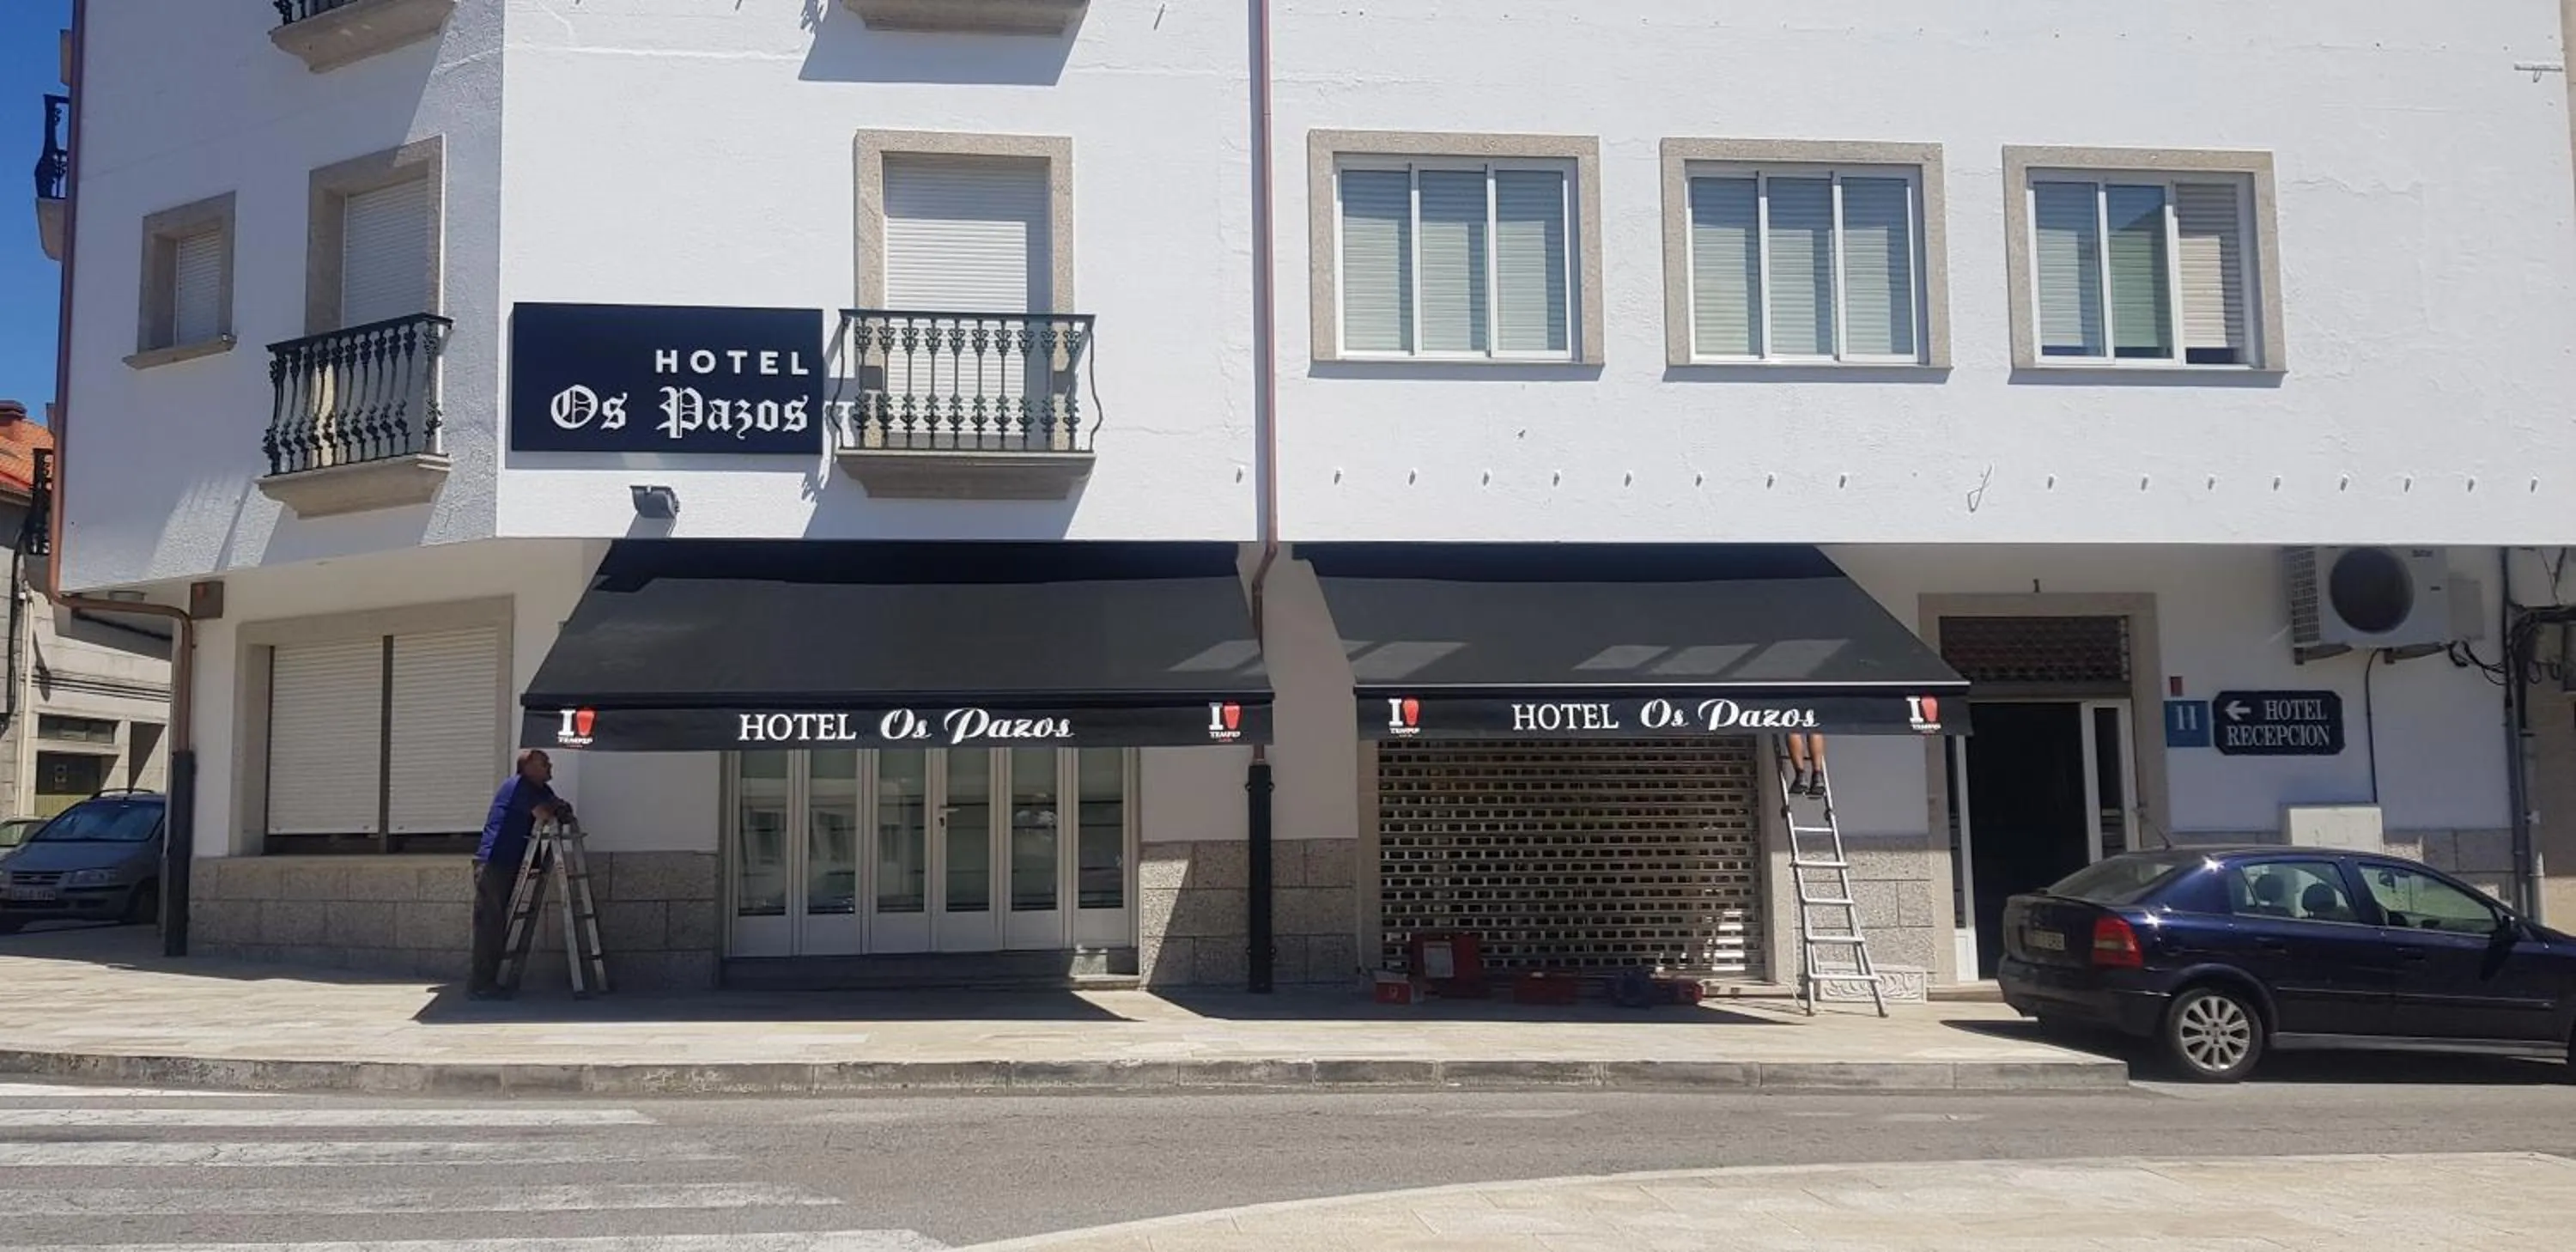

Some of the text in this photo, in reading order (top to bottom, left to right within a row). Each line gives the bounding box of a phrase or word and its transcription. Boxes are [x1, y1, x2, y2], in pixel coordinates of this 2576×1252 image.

[655, 349, 809, 375] HOTEL
[550, 384, 809, 440] Os Pazos
[2032, 579, 2041, 593] 1
[1511, 698, 1820, 731] HOTEL Os Pazos
[2264, 699, 2328, 720] HOTEL
[738, 708, 1075, 745] HOTEL Os Pazos
[2227, 725, 2330, 746] RECEPCION
